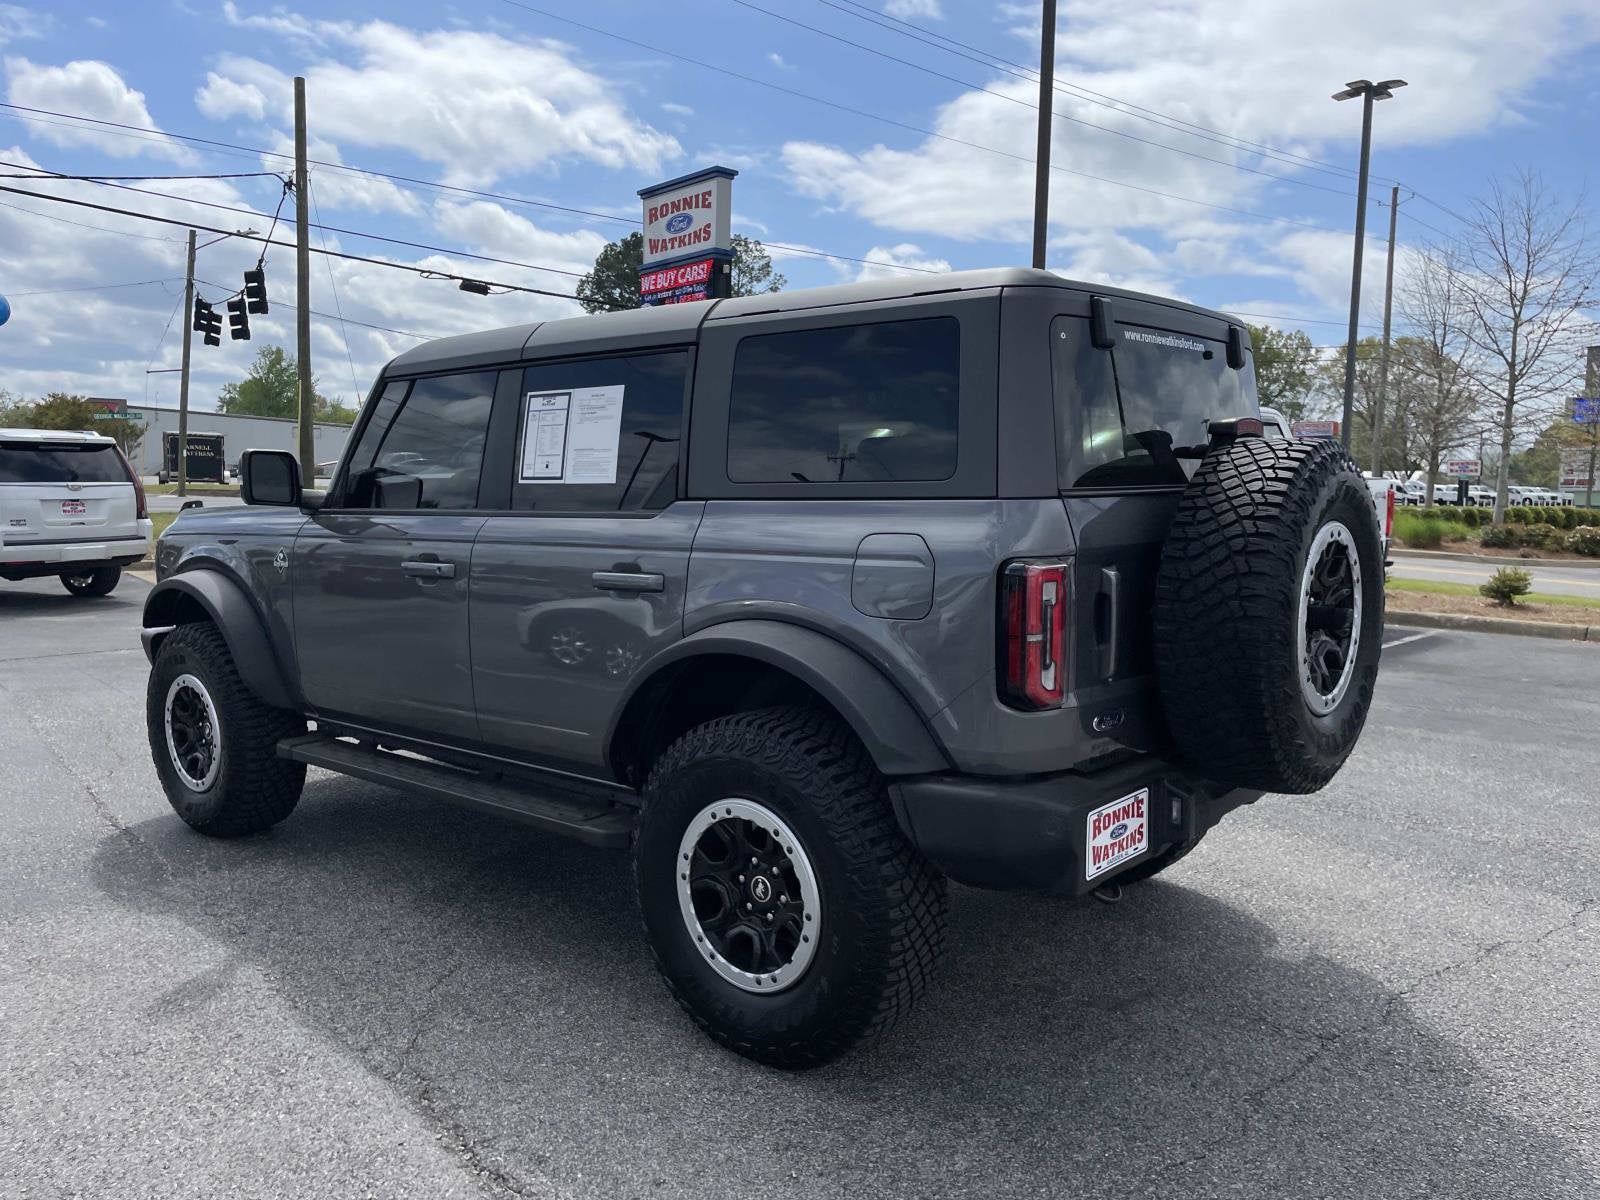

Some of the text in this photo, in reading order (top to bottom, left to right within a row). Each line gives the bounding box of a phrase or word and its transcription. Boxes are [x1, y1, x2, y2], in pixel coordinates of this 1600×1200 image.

[648, 190, 712, 226] RONNIE
[648, 223, 712, 255] WATKINS
[641, 264, 707, 291] WE BUY CARS!
[1124, 330, 1205, 352] www.ronniewatkinsford.com
[1092, 798, 1144, 841] RONNIE
[1092, 823, 1144, 866] WATKINS
